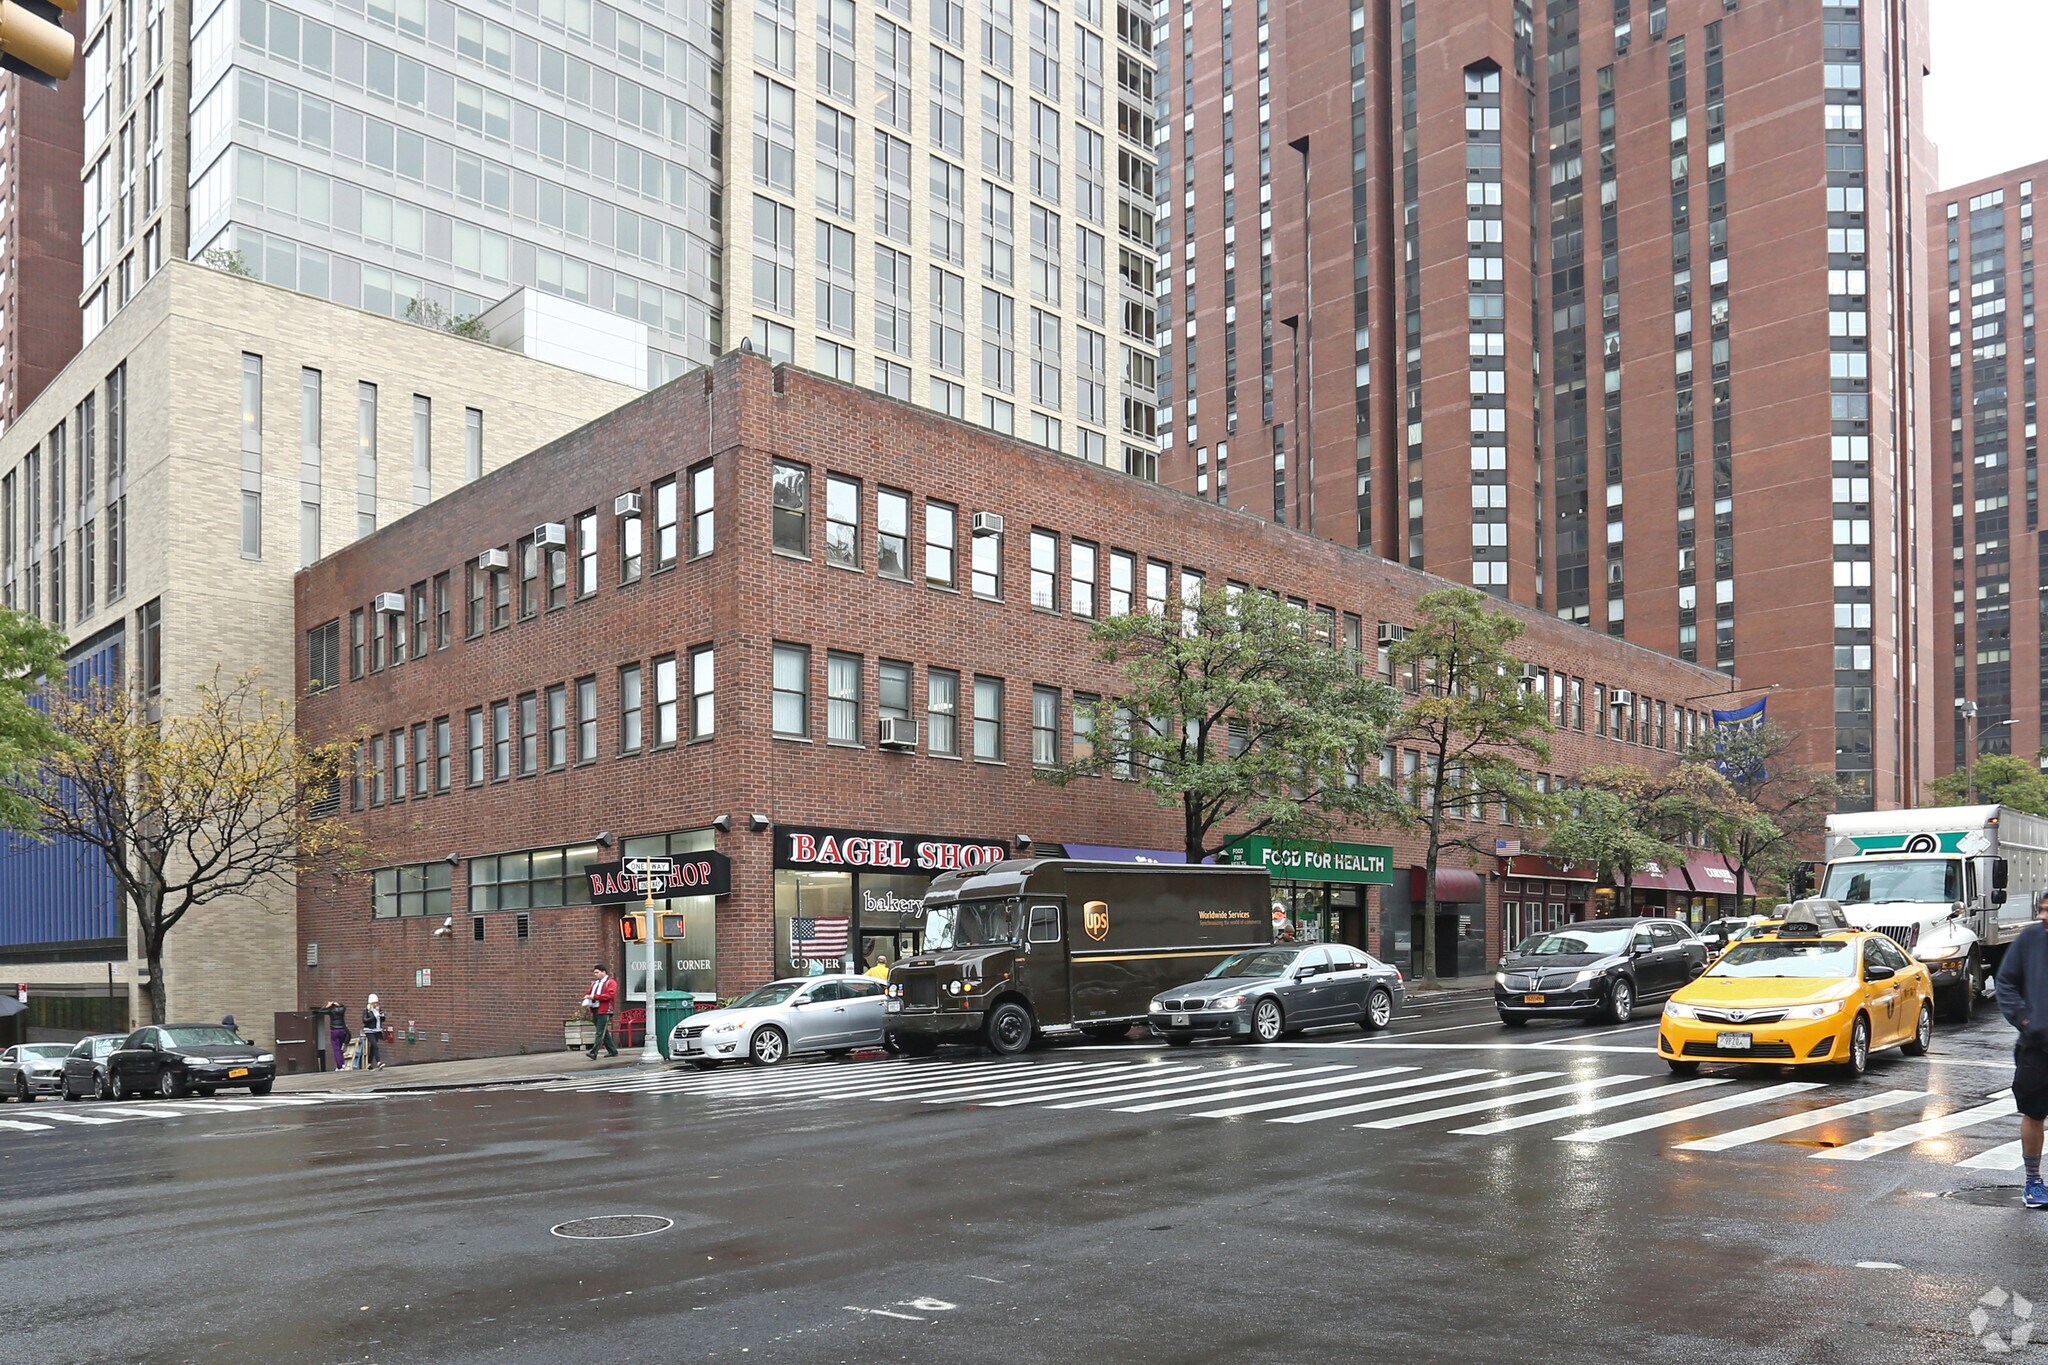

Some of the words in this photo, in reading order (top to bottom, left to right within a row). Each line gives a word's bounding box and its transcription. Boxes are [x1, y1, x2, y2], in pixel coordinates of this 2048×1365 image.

[789, 833, 910, 867] BAGEL
[917, 841, 1004, 869] SHOP
[1262, 848, 1301, 867] FOOD
[1305, 851, 1331, 869] FOR
[1334, 853, 1384, 873] HEALTH
[667, 861, 712, 888] HOP
[863, 890, 925, 918] bakery
[1198, 910, 1227, 919] Worldwide
[1228, 910, 1250, 919] Services
[1086, 912, 1107, 935] ups
[631, 960, 663, 971] CORER
[677, 959, 711, 970] CORNER
